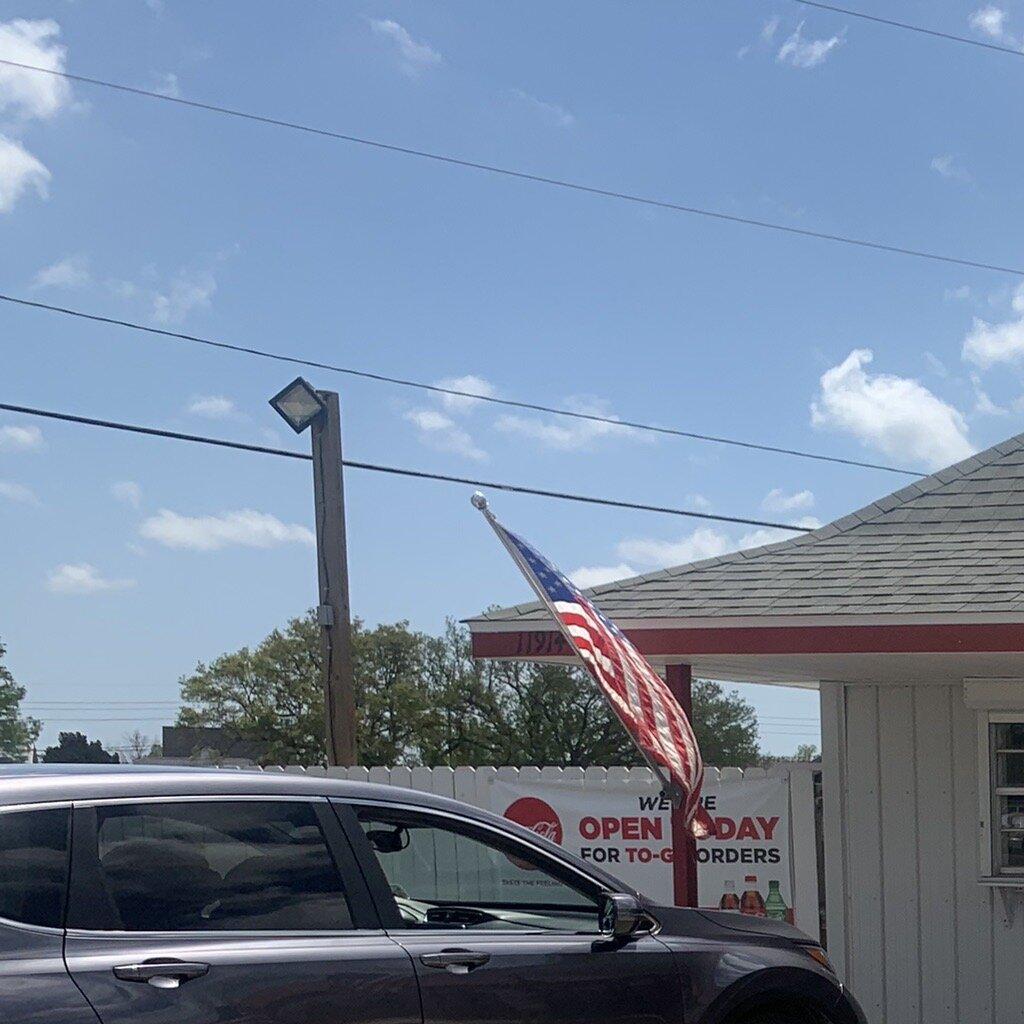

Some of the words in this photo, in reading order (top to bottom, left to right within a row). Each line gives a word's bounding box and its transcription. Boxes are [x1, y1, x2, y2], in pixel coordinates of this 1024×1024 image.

[638, 796, 670, 811] WE
[578, 816, 663, 841] OPEN
[696, 816, 780, 841] DAY
[580, 847, 620, 863] FOR
[625, 847, 674, 863] TO-G
[696, 848, 781, 863] ORDERS
